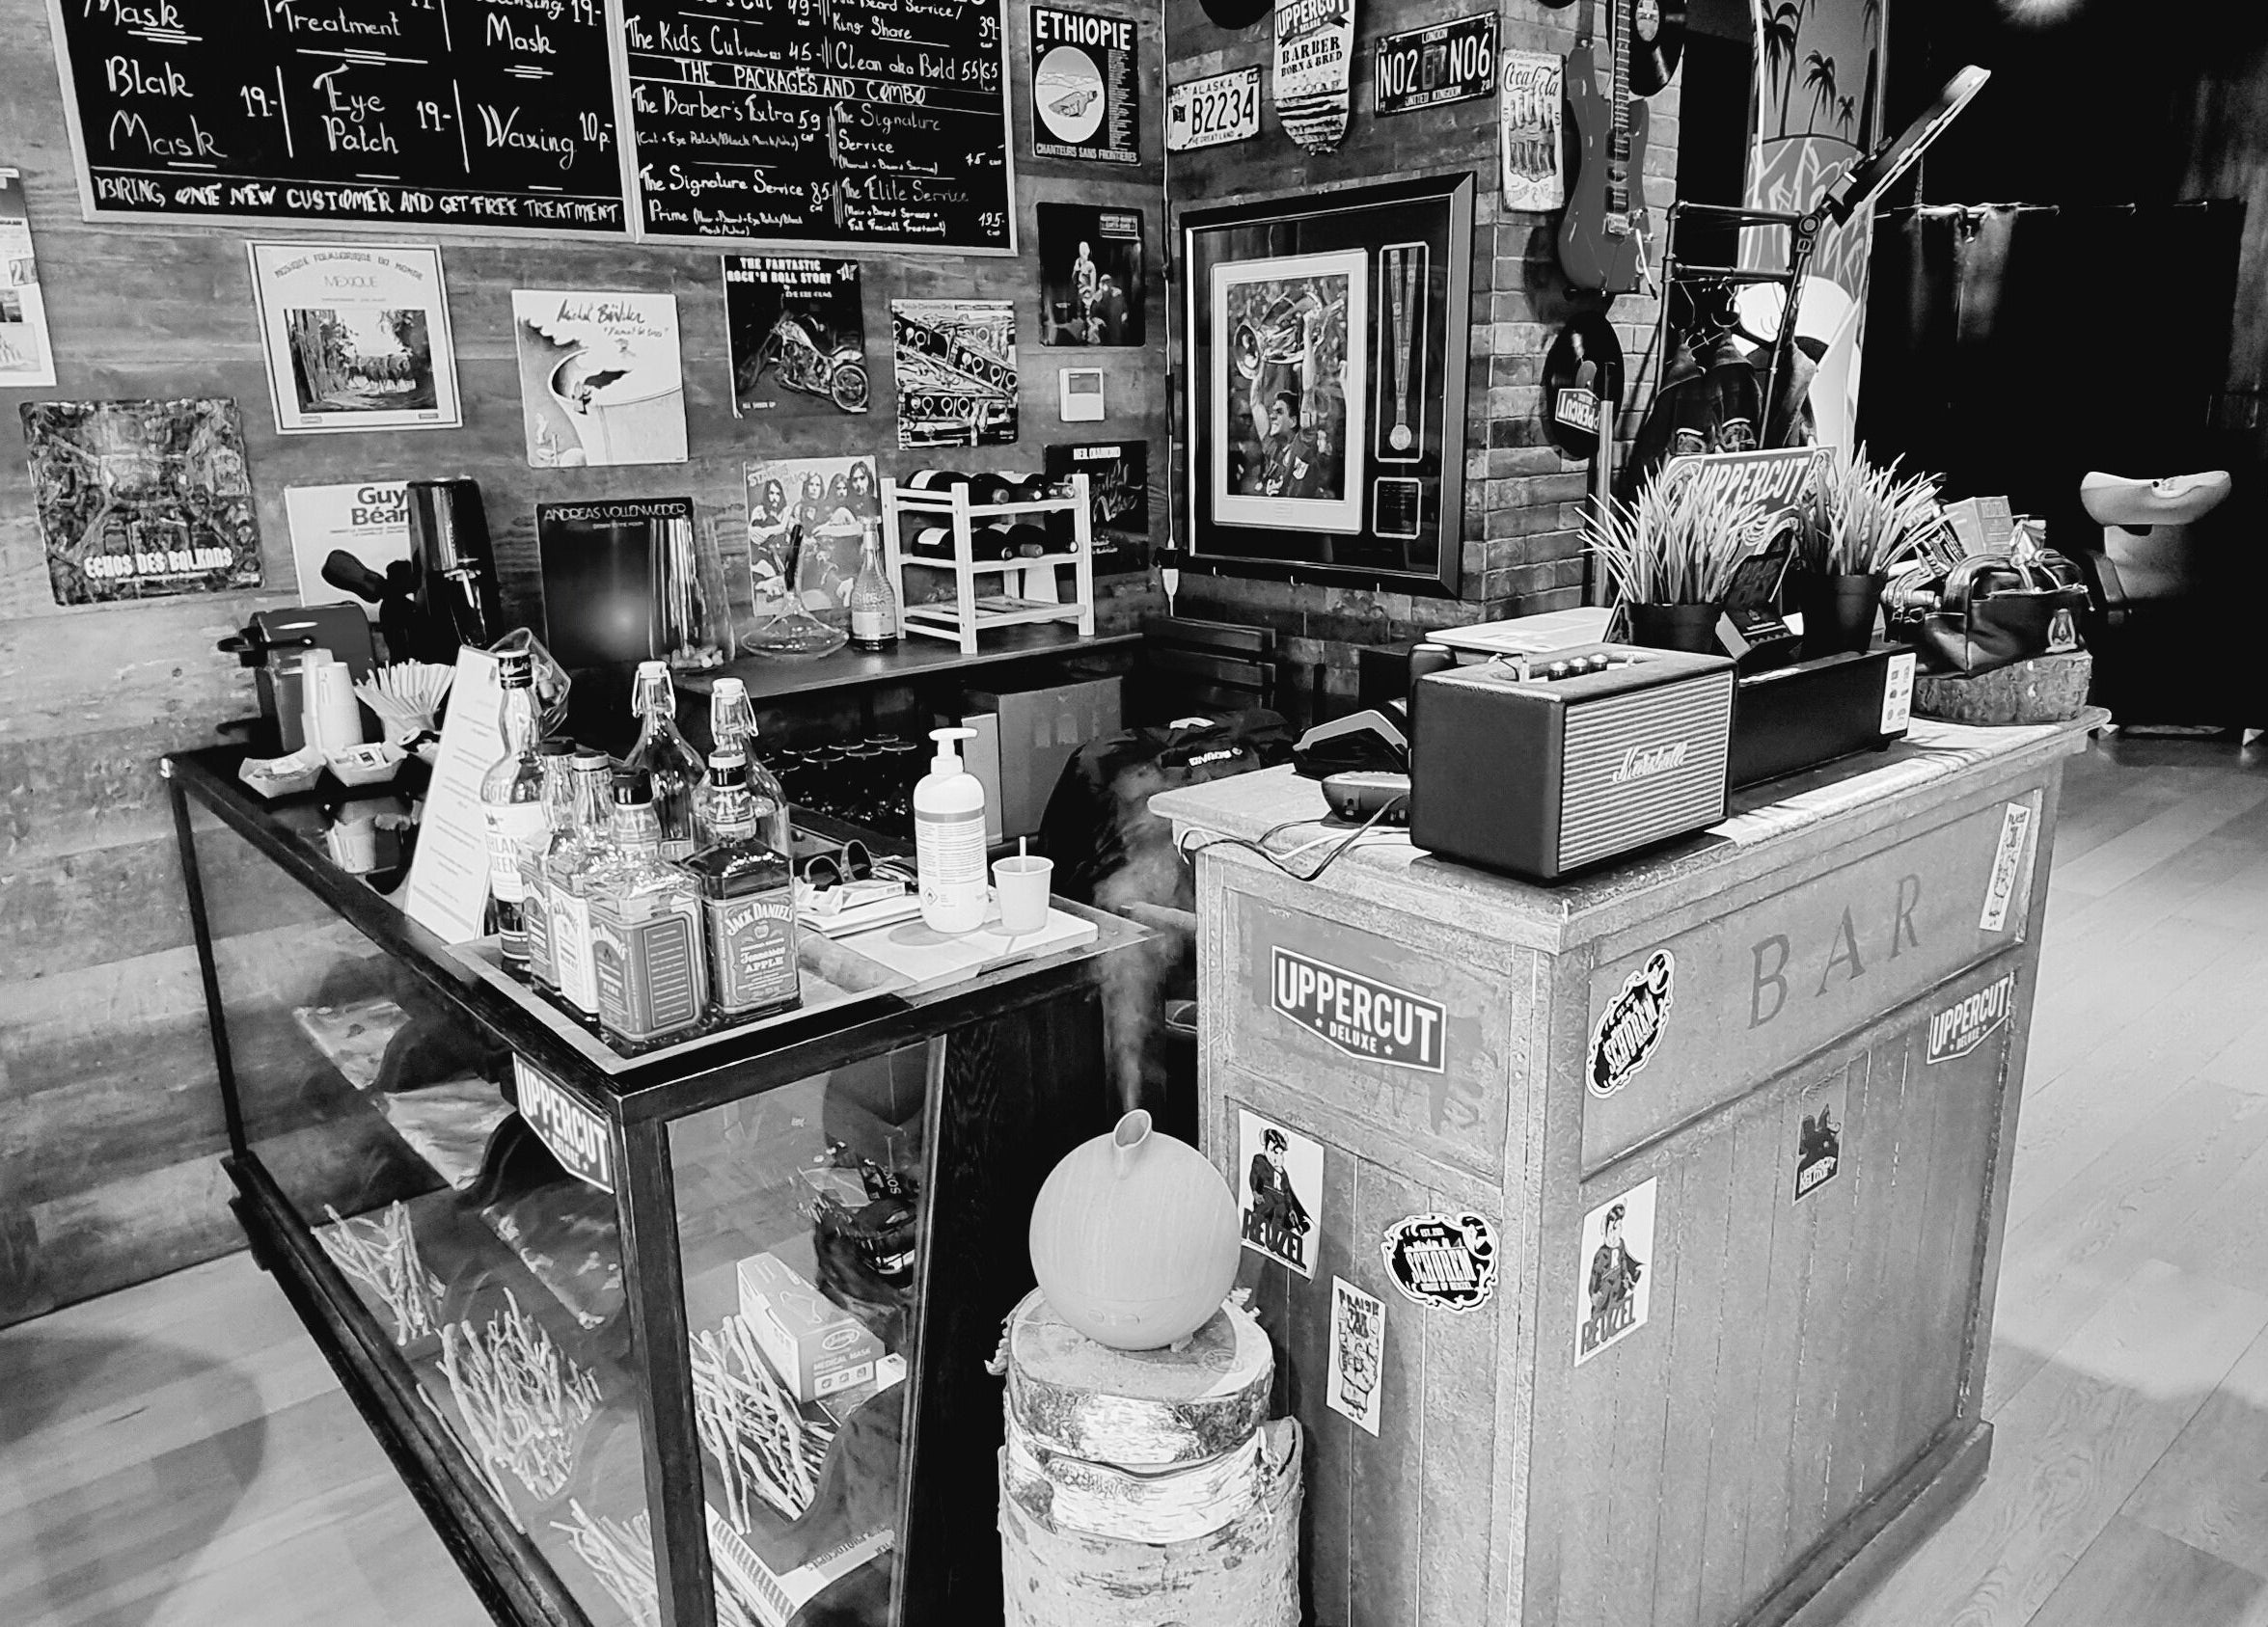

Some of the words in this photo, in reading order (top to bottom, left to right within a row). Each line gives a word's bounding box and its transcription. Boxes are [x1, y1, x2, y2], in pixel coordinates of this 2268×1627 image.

[276, 0, 400, 36] Treatment
[487, 13, 556, 54] Mask
[625, 14, 653, 49] The
[660, 21, 701, 54] Kids
[1036, 9, 1132, 51] ETHIOPIE
[1281, 62, 1304, 77] BORN
[1307, 59, 1313, 69] &
[1315, 50, 1343, 67] BRED
[1282, 37, 1340, 65] BARBER
[313, 64, 385, 122] Eye
[674, 58, 716, 85] THE
[734, 66, 818, 95] PACKAGES
[824, 75, 855, 97] AND
[866, 81, 926, 106] COMBO
[1192, 79, 1233, 95] ALASKA
[633, 85, 658, 114] The
[663, 86, 743, 122] Barber's
[834, 101, 855, 123] The
[1192, 85, 1254, 135] B2234
[110, 109, 228, 158] Mask
[321, 115, 399, 154] Patch
[478, 103, 577, 170] Waxing
[838, 128, 894, 152] Service
[1079, 147, 1097, 159] SANS
[640, 163, 666, 192] The
[669, 165, 748, 197] Signature
[753, 170, 804, 196] Service
[175, 182, 222, 206] ONE
[231, 183, 276, 206] NEW
[287, 187, 394, 213] CUSTOMER
[400, 191, 433, 213] AND
[440, 196, 469, 214] GET
[470, 196, 517, 217] FREE
[524, 199, 618, 223] TREATMENT
[649, 199, 689, 222] Prime
[740, 257, 761, 270] THE
[766, 258, 821, 271] FANTASTIC
[771, 272, 797, 284] ROLL
[801, 272, 832, 284] STORY
[357, 487, 406, 508] Guy
[544, 506, 601, 521] ANDREAS
[84, 555, 133, 578] ECHOS
[136, 552, 166, 574] DES
[1613, 742, 1687, 782] Marshall
[724, 908, 754, 936] JACK
[745, 956, 784, 973] APPLE
[1748, 873, 1920, 1030] BAR
[1277, 957, 1438, 1063] UPPERCUT
[1932, 977, 2009, 1055] UPPERCUT
[1329, 1020, 1378, 1054] DELUXE
[517, 1063, 608, 1182] UPPERCUT
